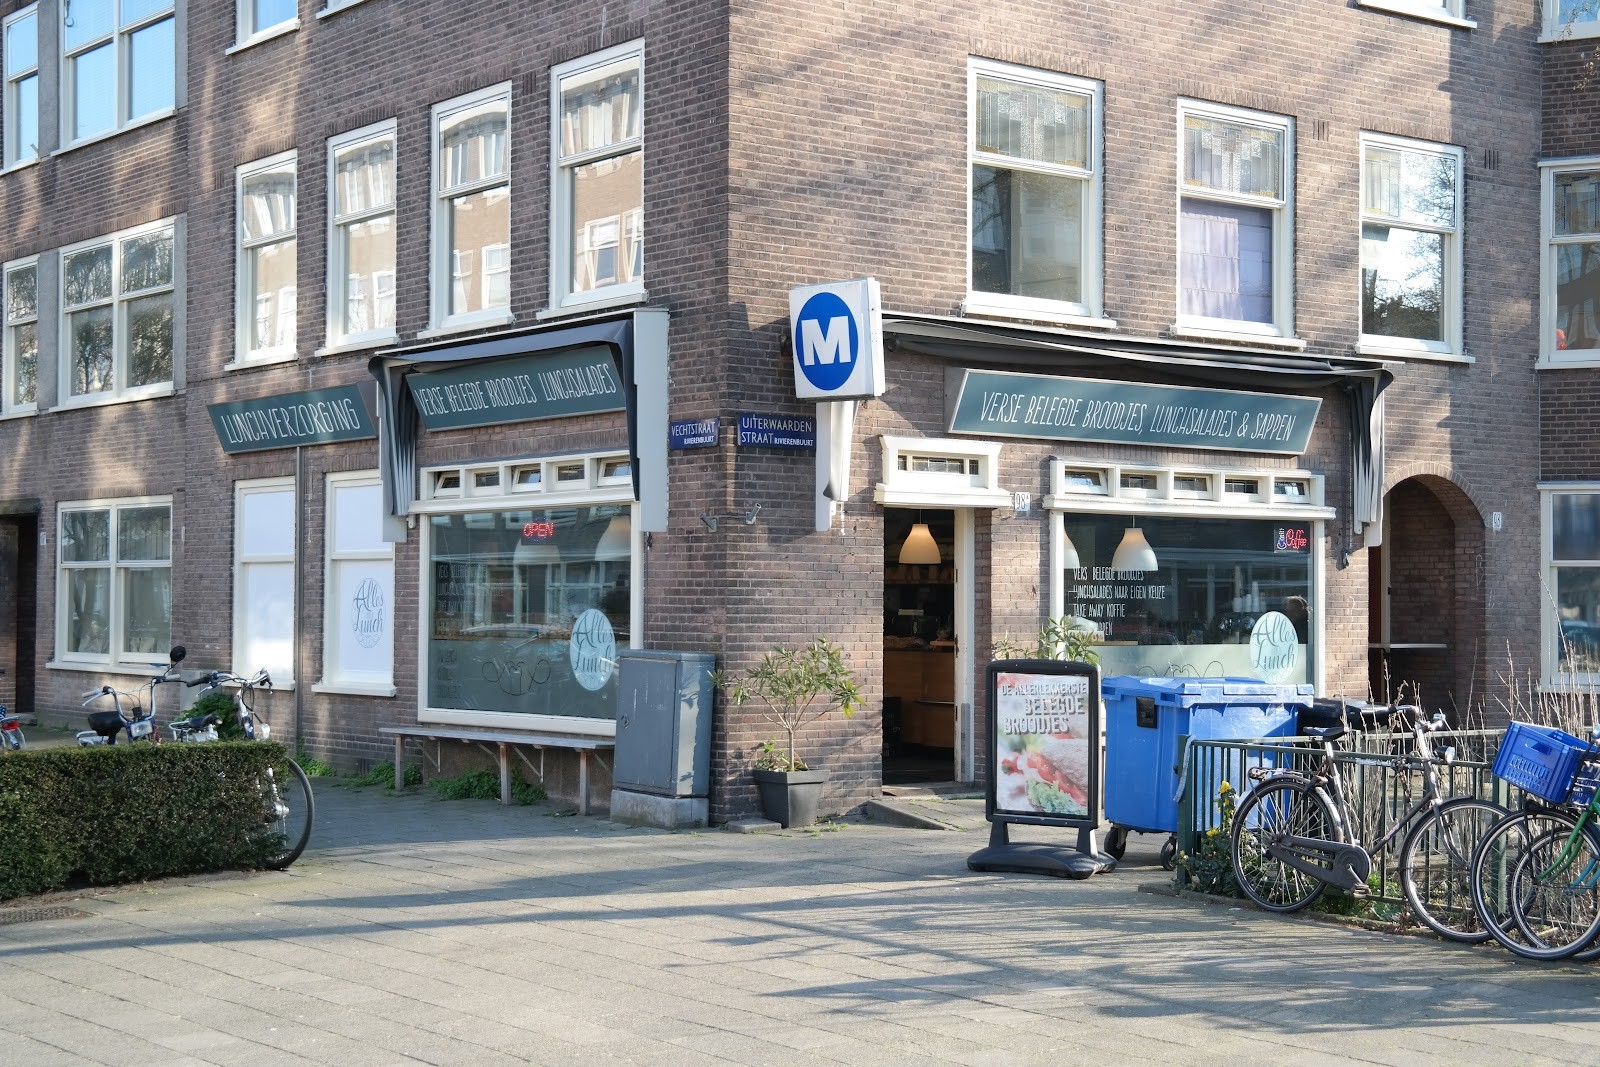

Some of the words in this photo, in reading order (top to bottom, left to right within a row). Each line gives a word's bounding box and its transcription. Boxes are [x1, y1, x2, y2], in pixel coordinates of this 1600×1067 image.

[802, 316, 851, 366] M
[414, 386, 450, 416] VERSE
[444, 381, 490, 413] BELEGDE
[484, 374, 538, 408] BROODJES
[538, 363, 617, 401] LUNCHSALADES
[221, 398, 361, 444] LUNCHVERZORGING
[671, 421, 716, 437] VECHTSTRAAT
[742, 416, 812, 433] UITERWAARDEN
[980, 391, 1025, 424] VERSE
[1024, 395, 1083, 427] BELEGDE
[1081, 399, 1148, 435] BROODJES,
[1149, 404, 1238, 438] LUNCHSALADES
[1236, 412, 1250, 438] &
[1250, 412, 1297, 442] SAPPEN
[741, 431, 774, 444] STRAAT
[774, 437, 814, 447] RIVIERENBUURT
[523, 522, 554, 537] OPEN
[1285, 528, 1307, 550] Coffee
[353, 579, 384, 611] Alles
[1130, 585, 1147, 599] EIGEN
[354, 604, 383, 633] Lunch
[573, 610, 613, 648] Alles
[1252, 613, 1296, 647] Alles
[1254, 639, 1295, 670] Lunch
[1002, 684, 1013, 696] DE
[1025, 696, 1086, 716] BELEGDE
[1004, 717, 1071, 736] BROODJES
